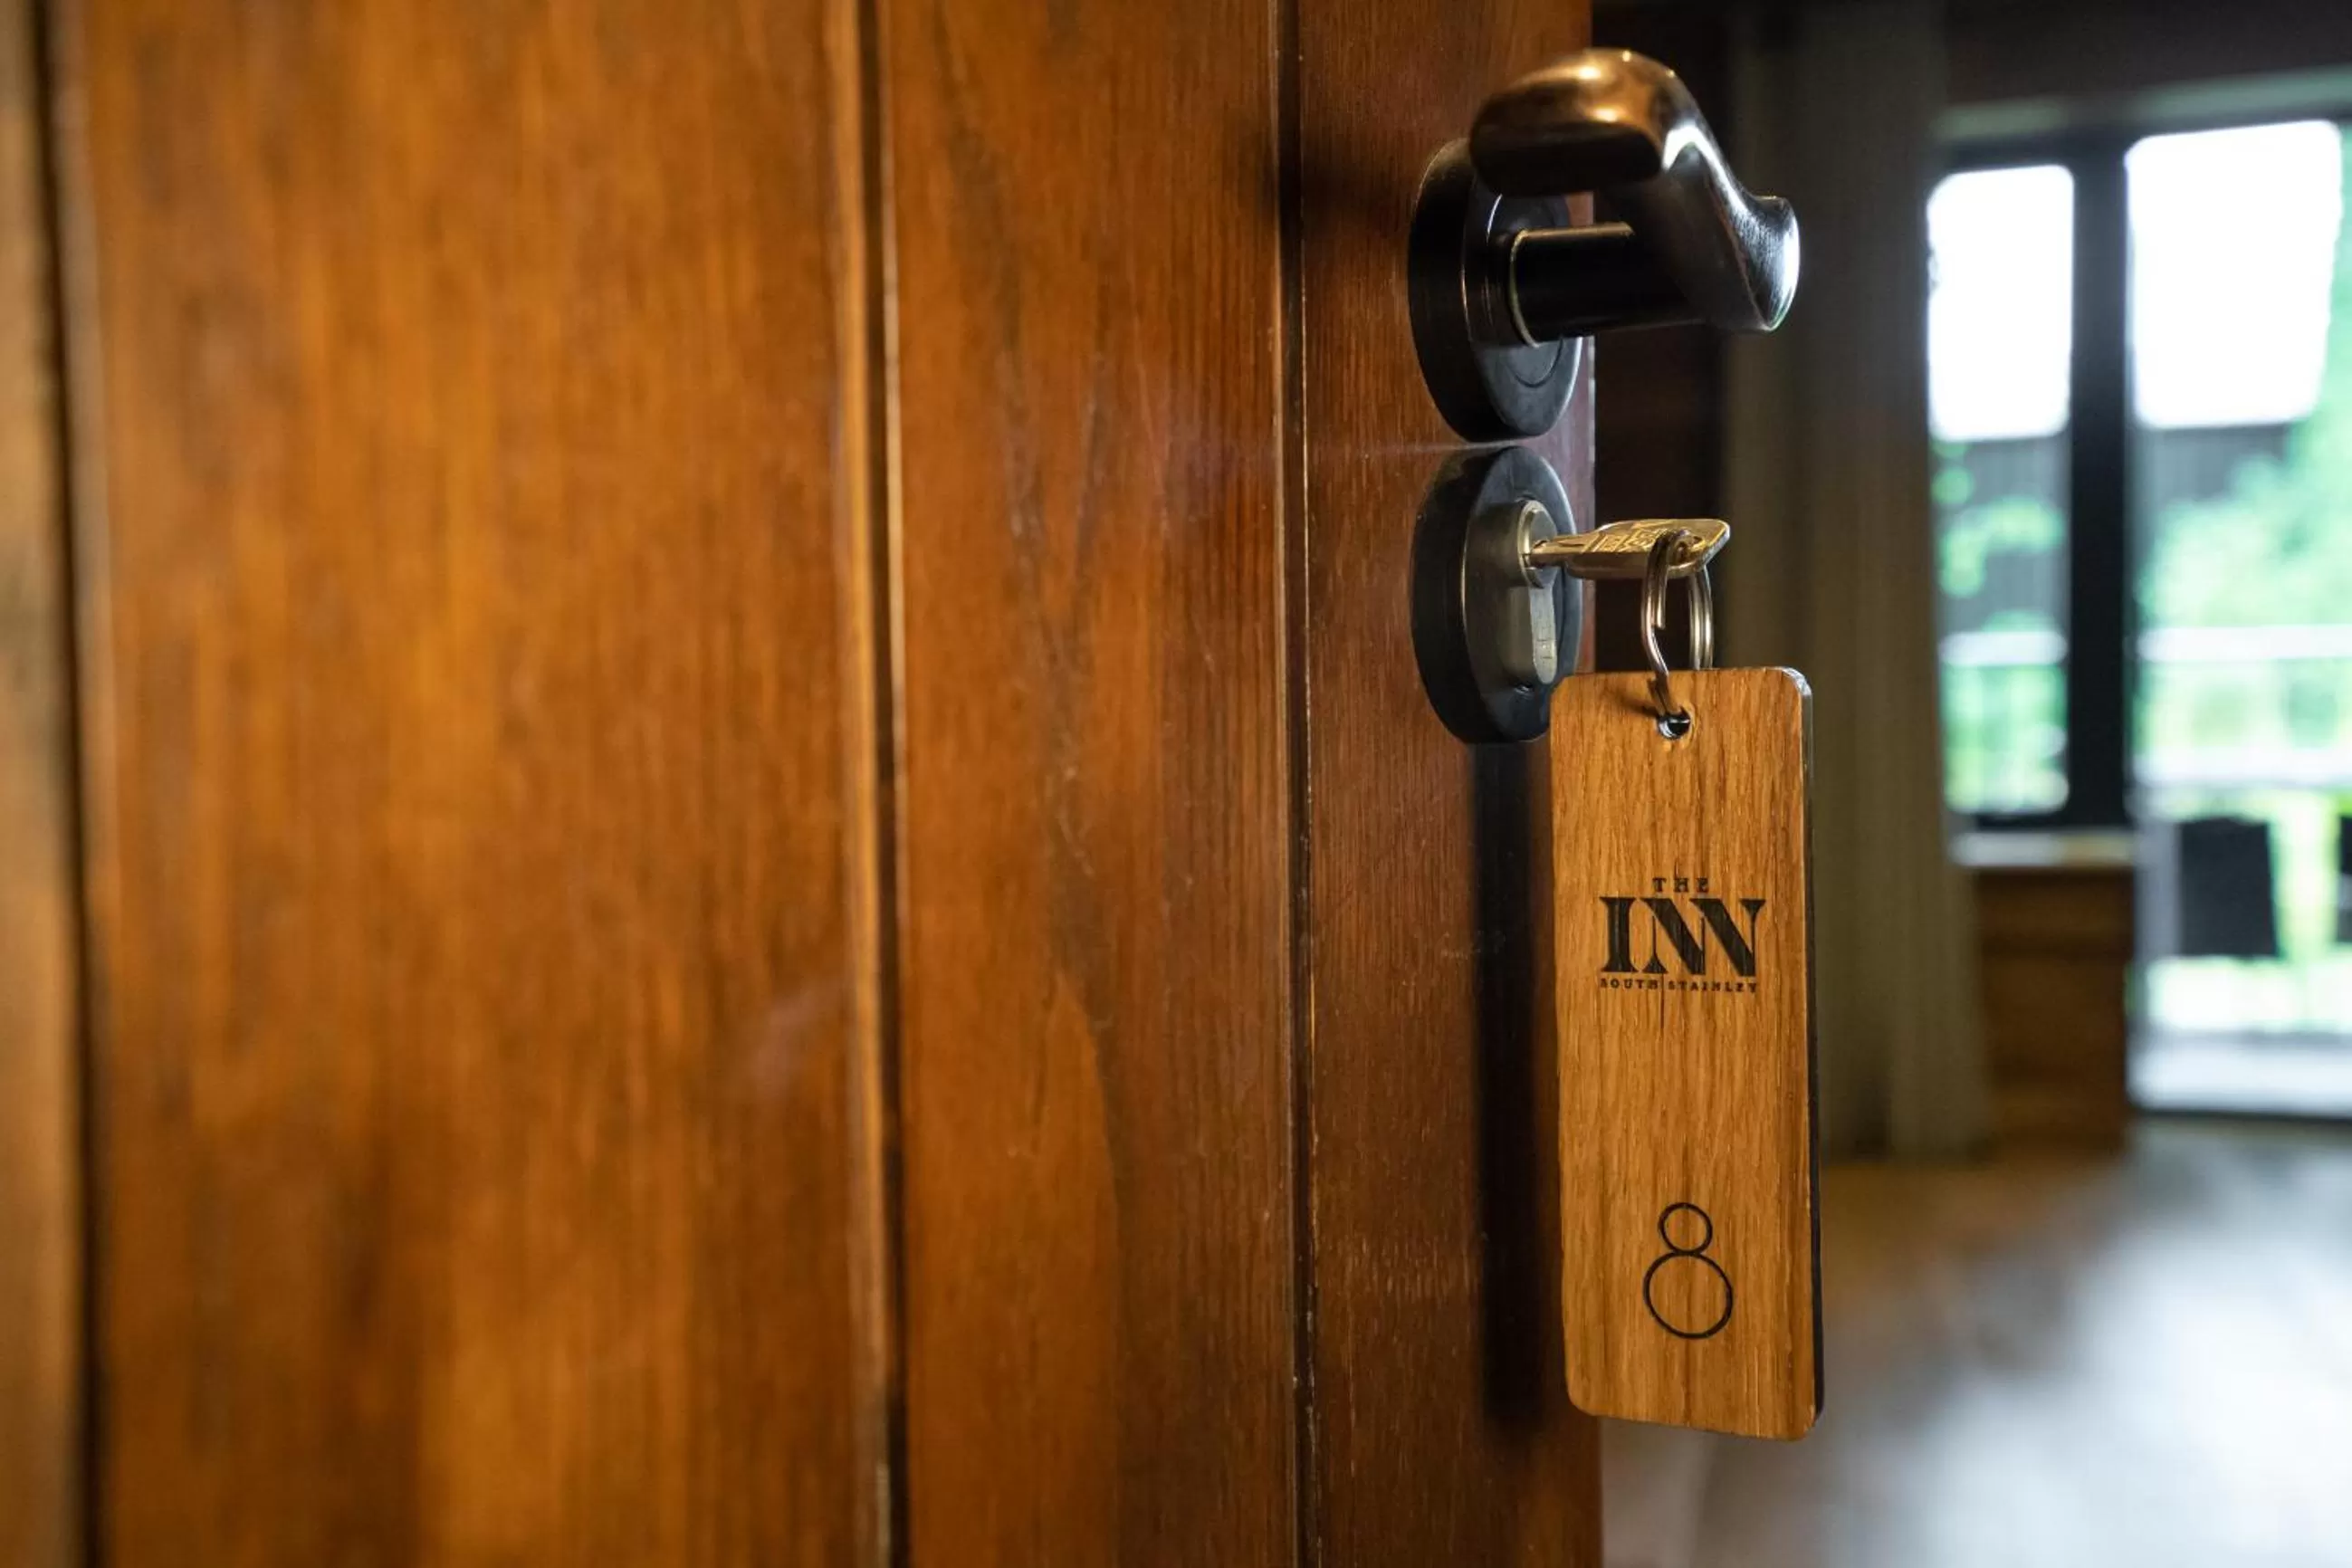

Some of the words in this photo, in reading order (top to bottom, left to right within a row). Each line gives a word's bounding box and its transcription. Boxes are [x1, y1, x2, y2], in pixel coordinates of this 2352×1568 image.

[1652, 877, 1708, 893] THE
[1599, 896, 1766, 977] INN
[1600, 978, 1658, 990] SOUTH
[1643, 1202, 1734, 1340] 8
